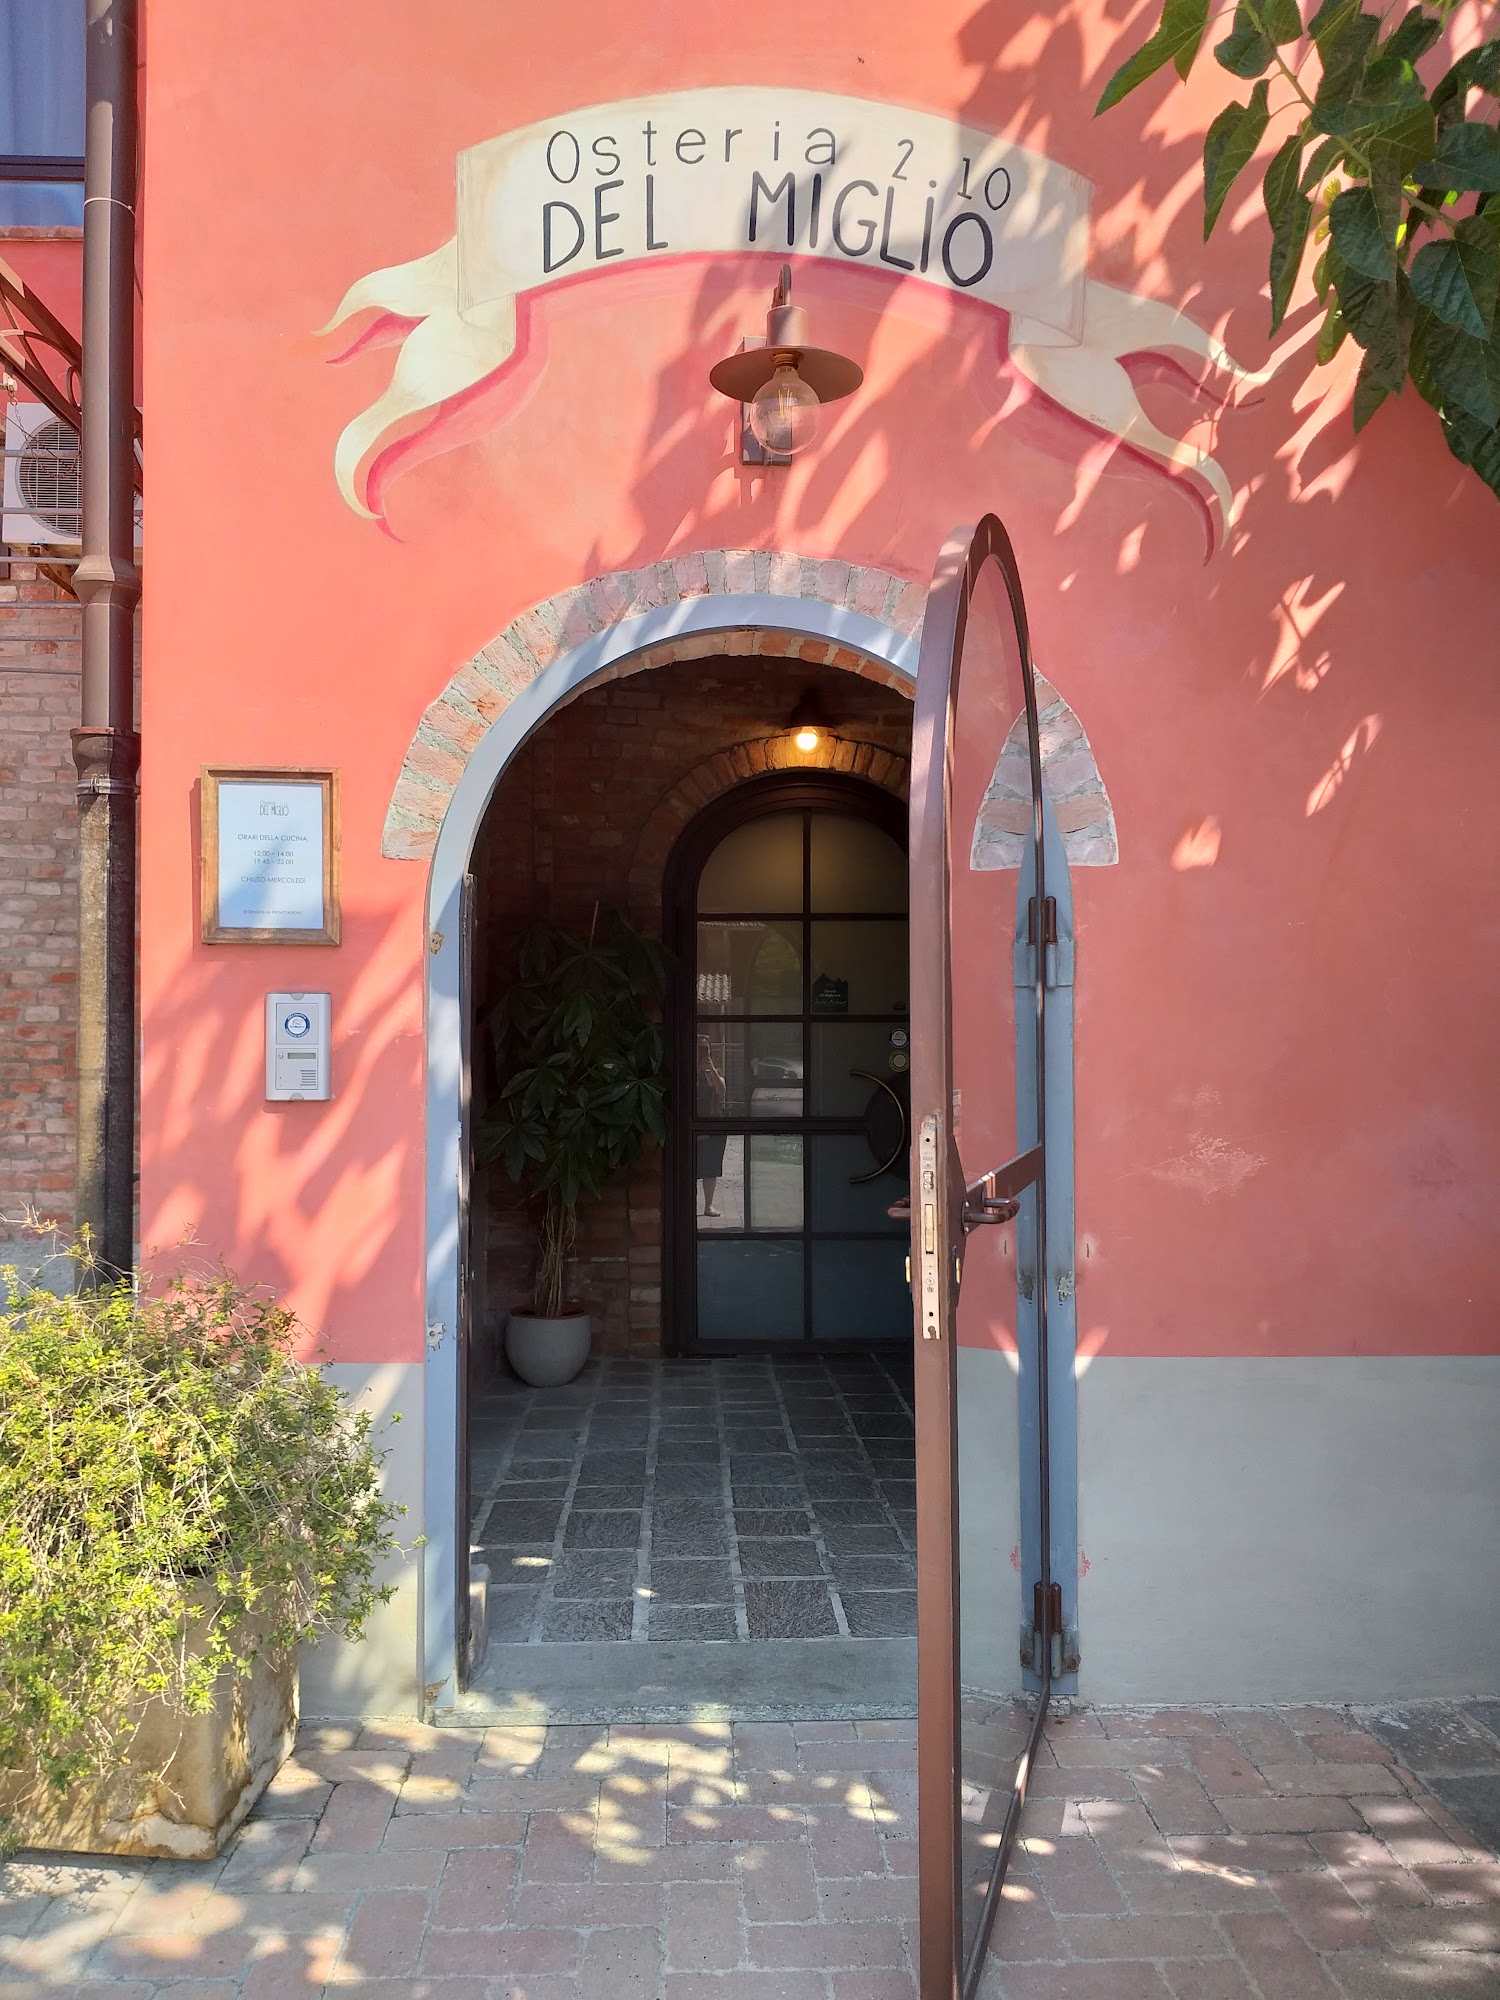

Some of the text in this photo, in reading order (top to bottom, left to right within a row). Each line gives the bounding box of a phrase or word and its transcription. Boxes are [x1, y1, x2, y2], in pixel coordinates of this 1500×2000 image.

[546, 120, 839, 184] Osteria
[542, 174, 669, 274] DEL
[237, 833, 258, 841] ORARI
